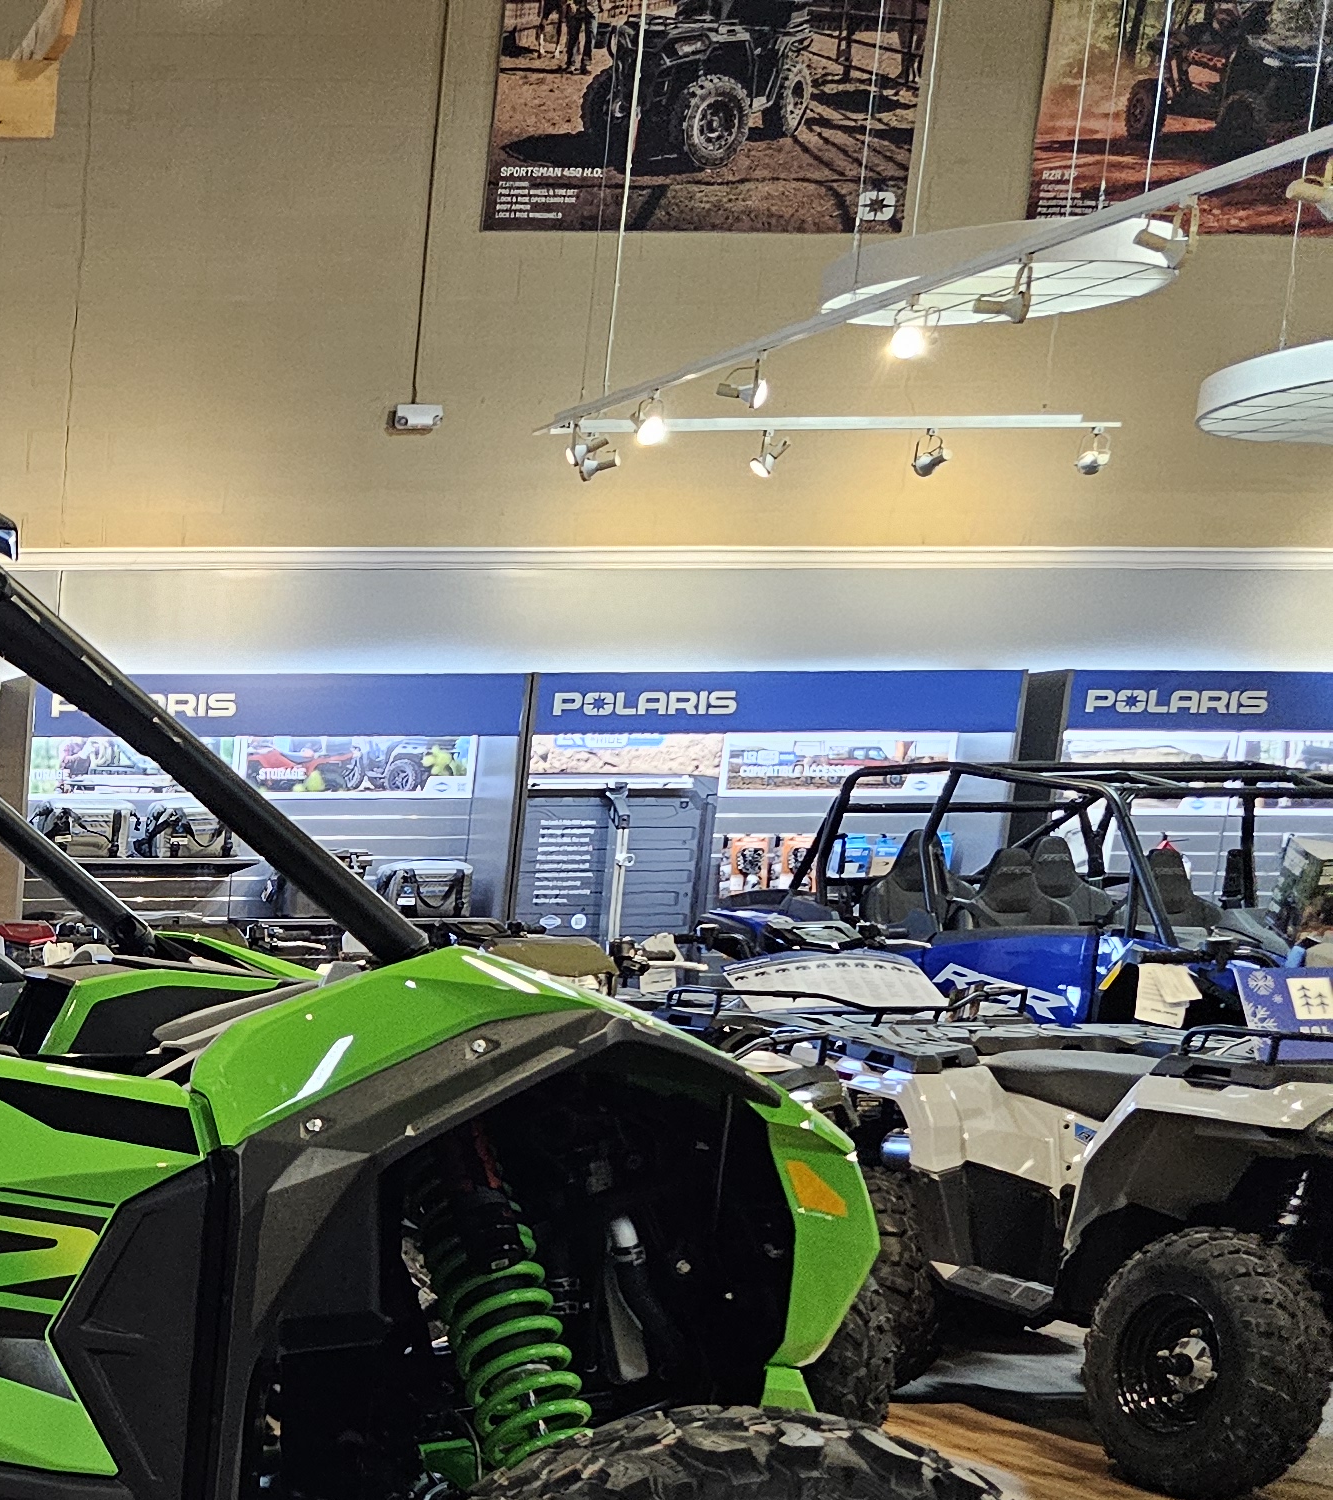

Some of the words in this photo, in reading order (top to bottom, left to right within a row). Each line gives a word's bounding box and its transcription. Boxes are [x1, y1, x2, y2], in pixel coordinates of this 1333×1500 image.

[500, 166, 562, 177] SPORTSMAN
[1041, 170, 1062, 180] RZR
[51, 692, 237, 718] PRIS
[552, 689, 738, 716] POLARIS
[1084, 689, 1269, 715] POLARIS
[29, 768, 71, 780] TORAGE
[258, 767, 308, 780] STORAGE
